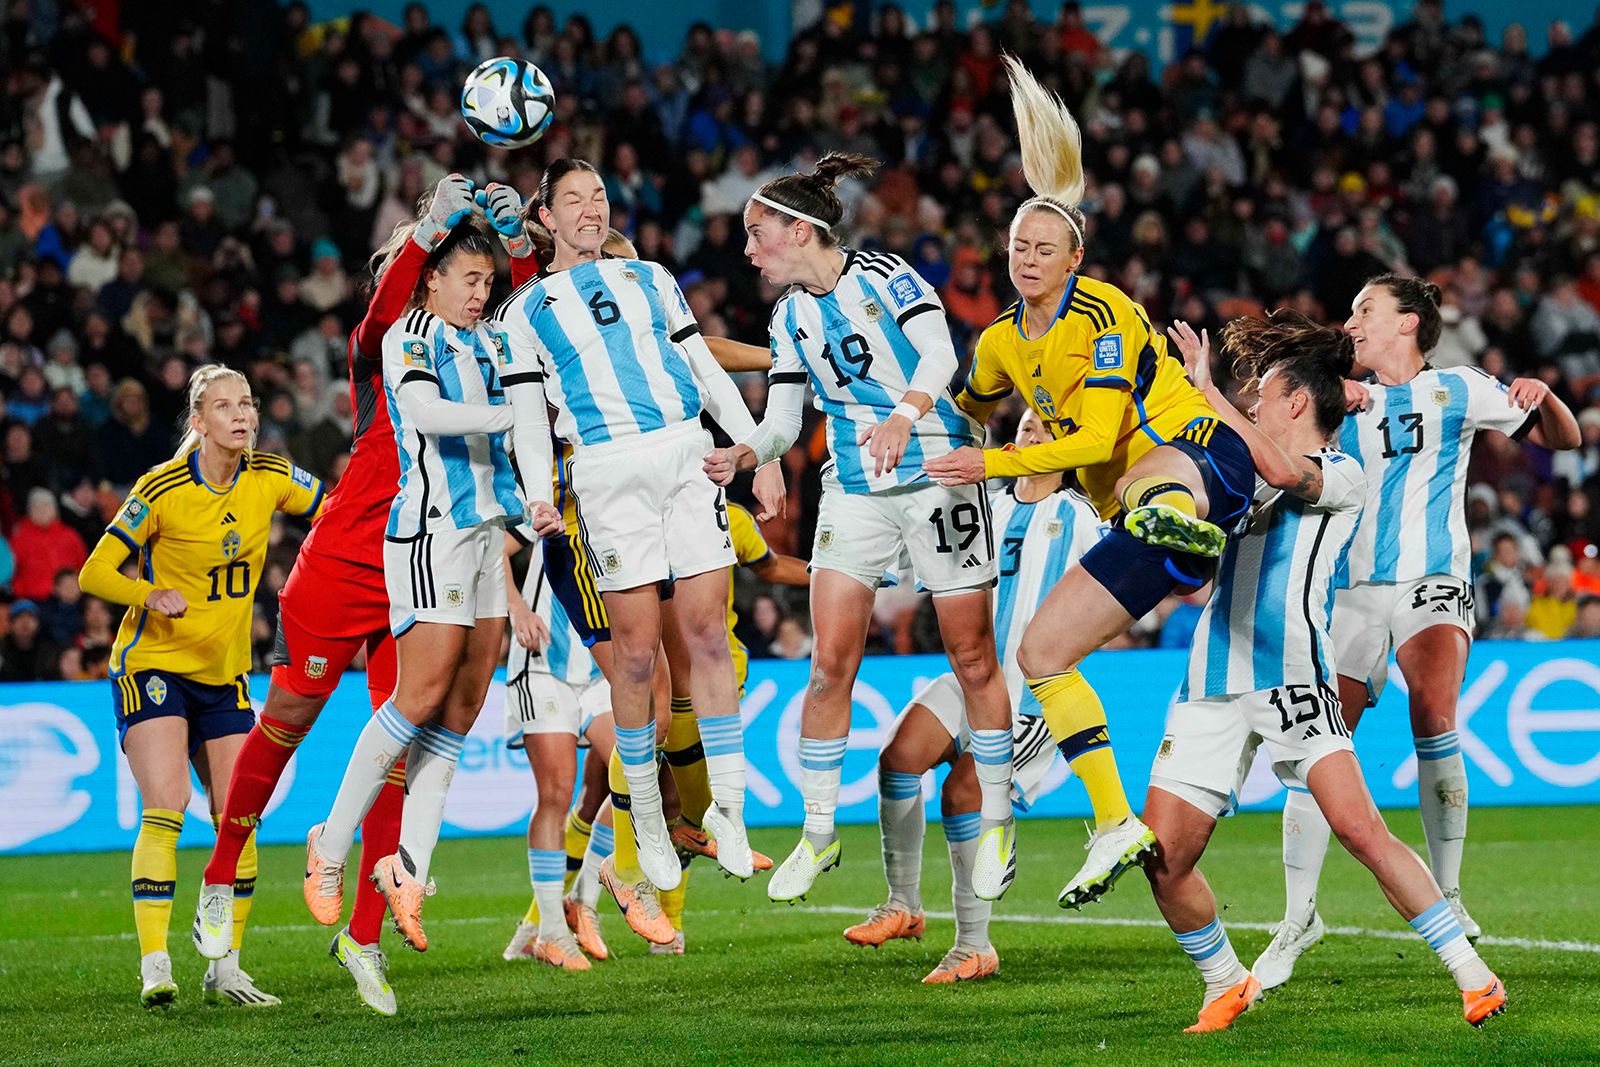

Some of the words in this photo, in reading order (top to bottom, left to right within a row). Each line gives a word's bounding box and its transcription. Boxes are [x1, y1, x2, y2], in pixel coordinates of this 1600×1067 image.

[588, 291, 621, 327] 6
[476, 357, 505, 397] 2
[821, 333, 873, 389] 19
[1377, 412, 1424, 459] 13
[714, 487, 729, 532] 6
[929, 503, 981, 554] 19
[207, 560, 250, 602] 10
[1411, 584, 1461, 609] 13
[1268, 685, 1321, 733] 15
